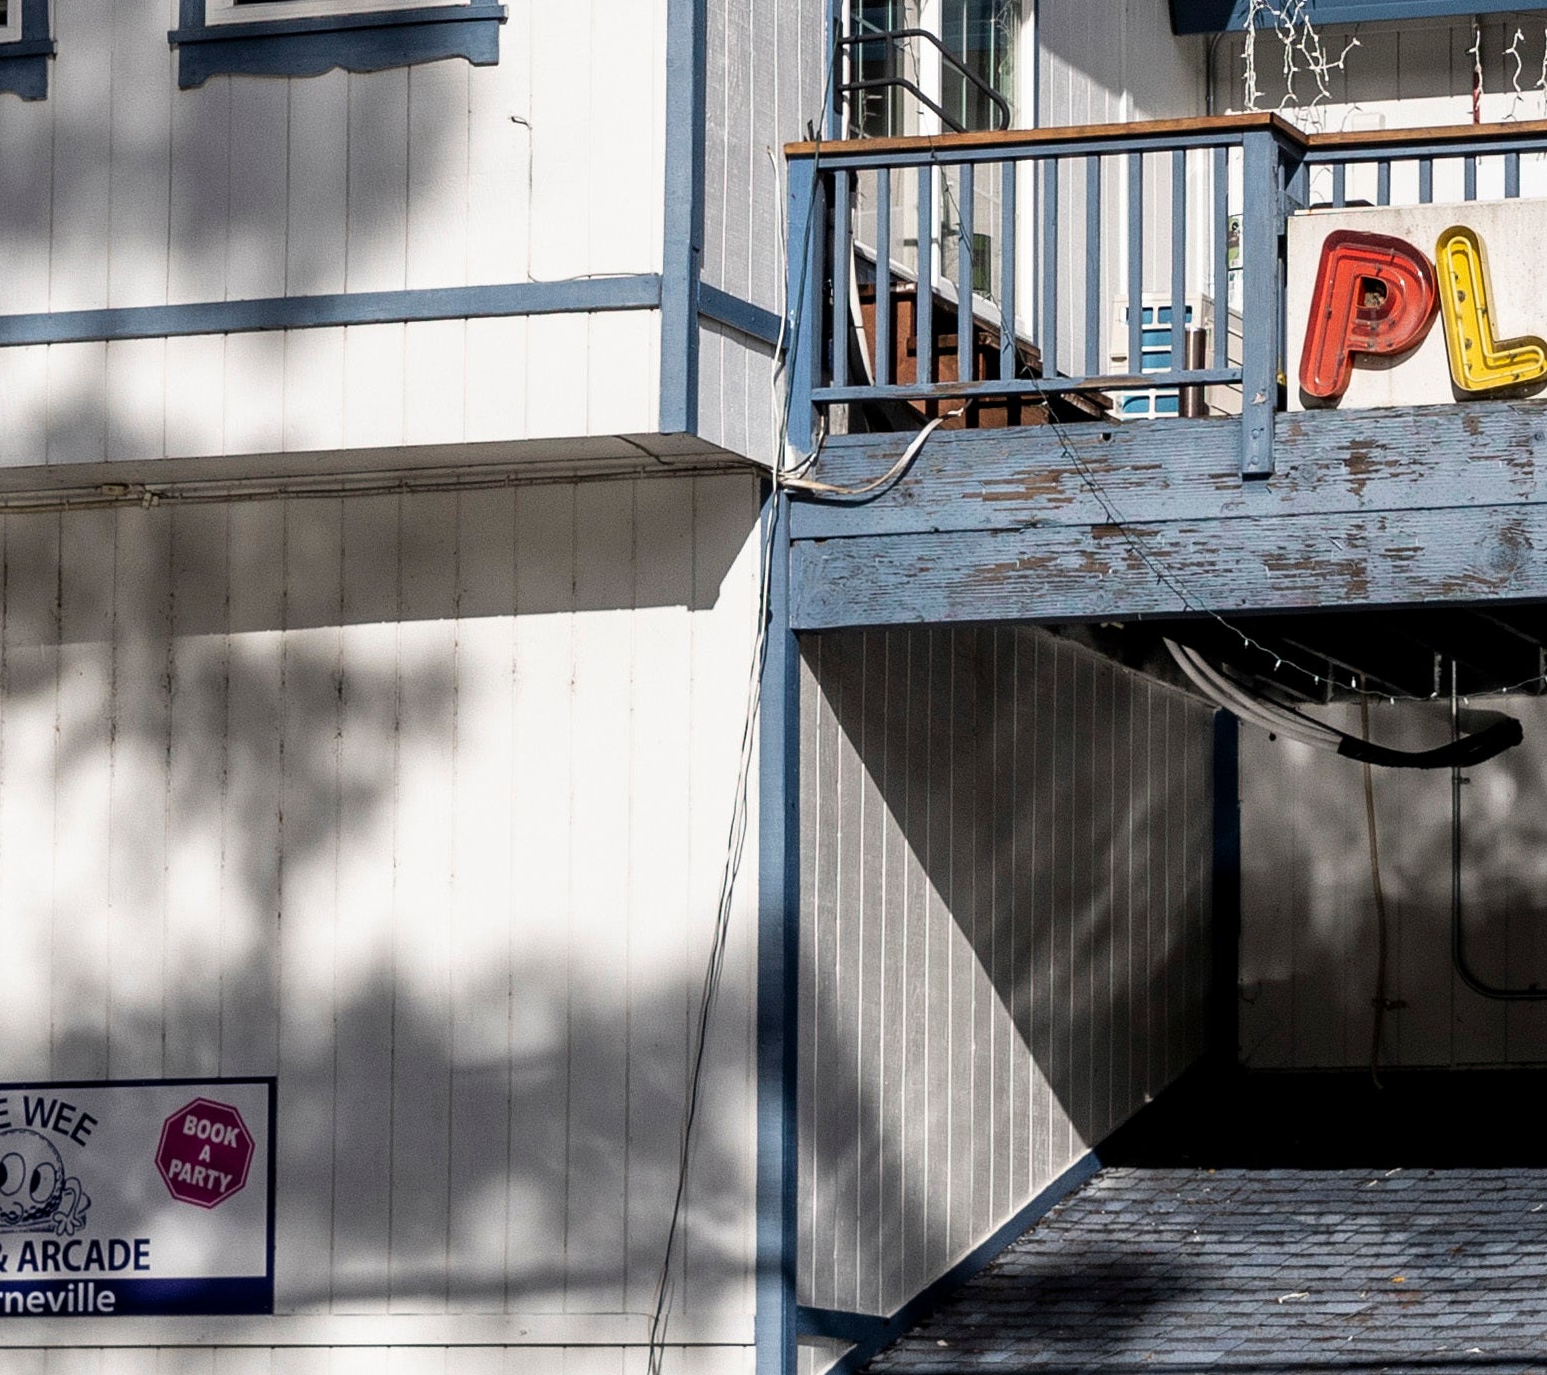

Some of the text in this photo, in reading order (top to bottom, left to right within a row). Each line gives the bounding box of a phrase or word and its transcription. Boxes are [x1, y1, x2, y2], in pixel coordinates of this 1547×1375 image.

[22, 1095, 98, 1147] WEE
[182, 1114, 240, 1149] BOOK
[198, 1144, 211, 1163] A
[168, 1158, 233, 1194] PARTY
[16, 1237, 151, 1273] ARCADE
